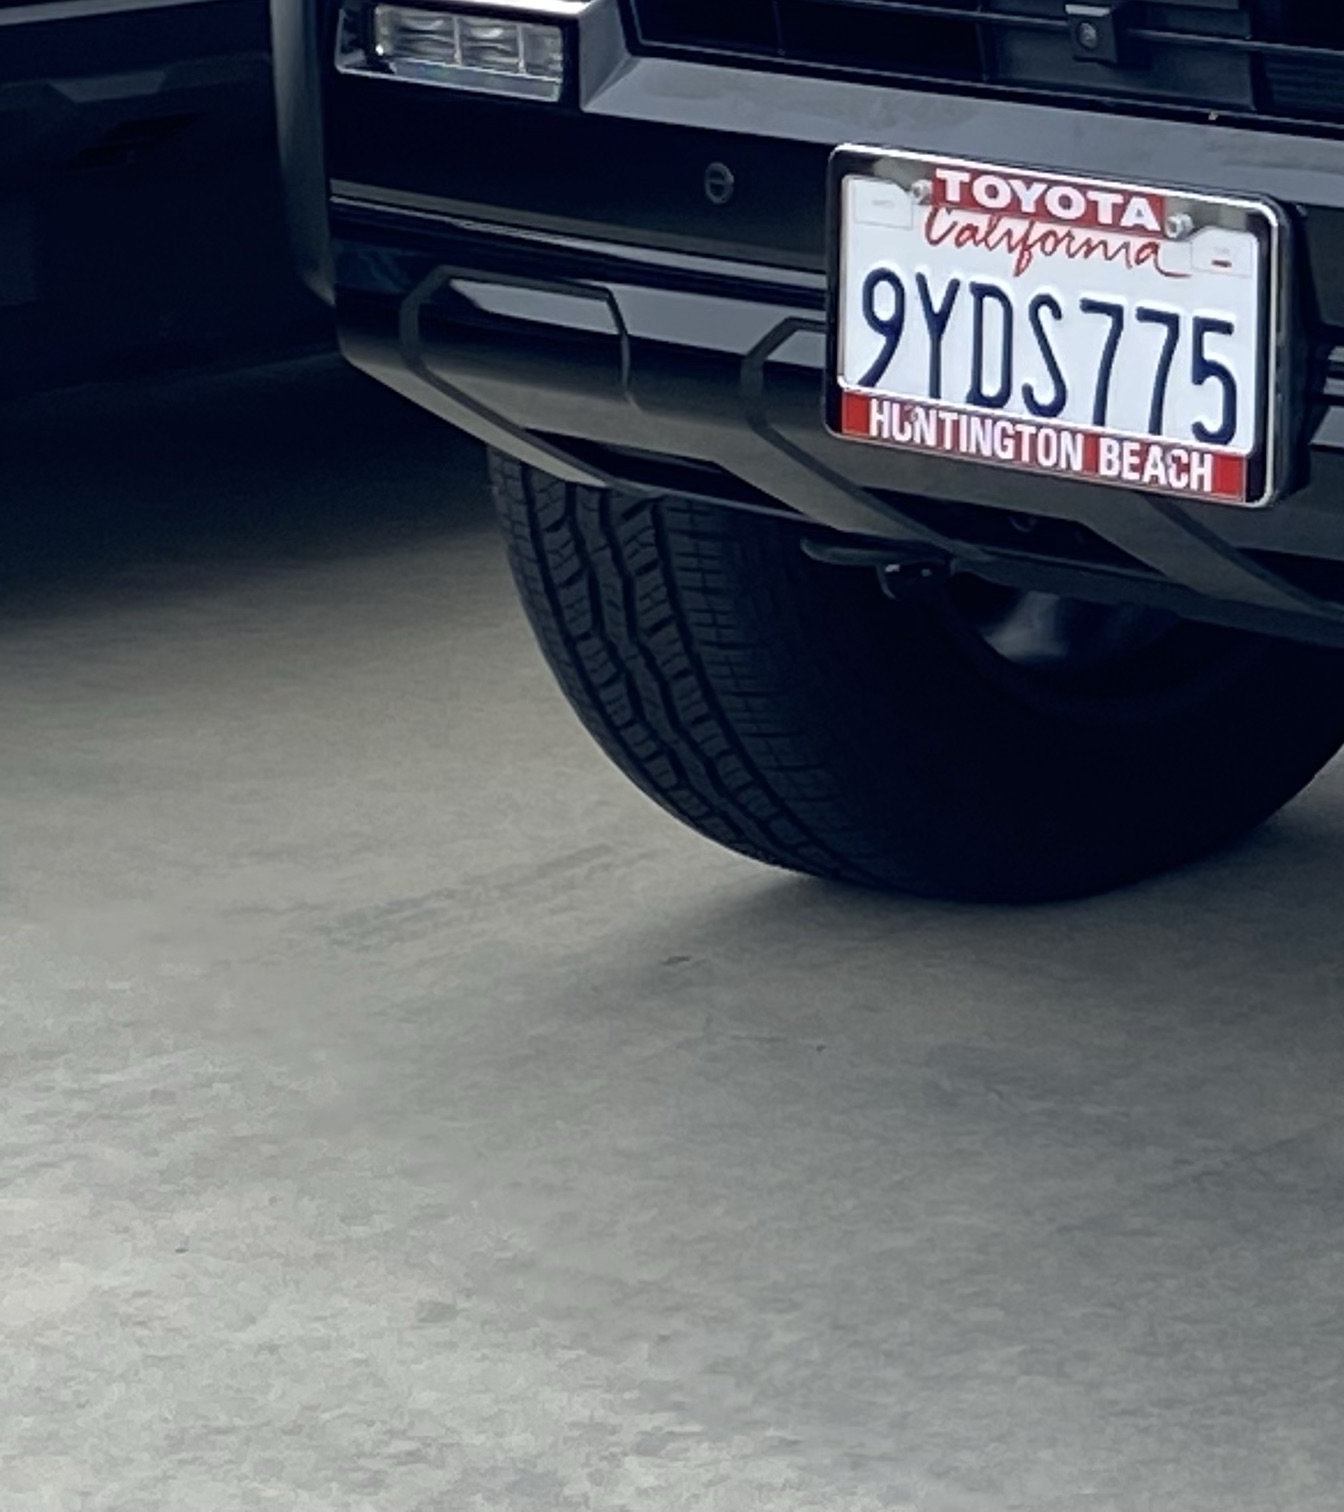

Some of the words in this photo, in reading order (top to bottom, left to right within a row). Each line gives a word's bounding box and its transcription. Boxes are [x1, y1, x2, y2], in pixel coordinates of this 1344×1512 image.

[936, 169, 1161, 231] TOYOTA
[923, 206, 1194, 277] California
[860, 268, 1238, 445] 9YDS775
[868, 399, 1083, 471] HUNTINGTON
[1100, 443, 1213, 492] BEACH
